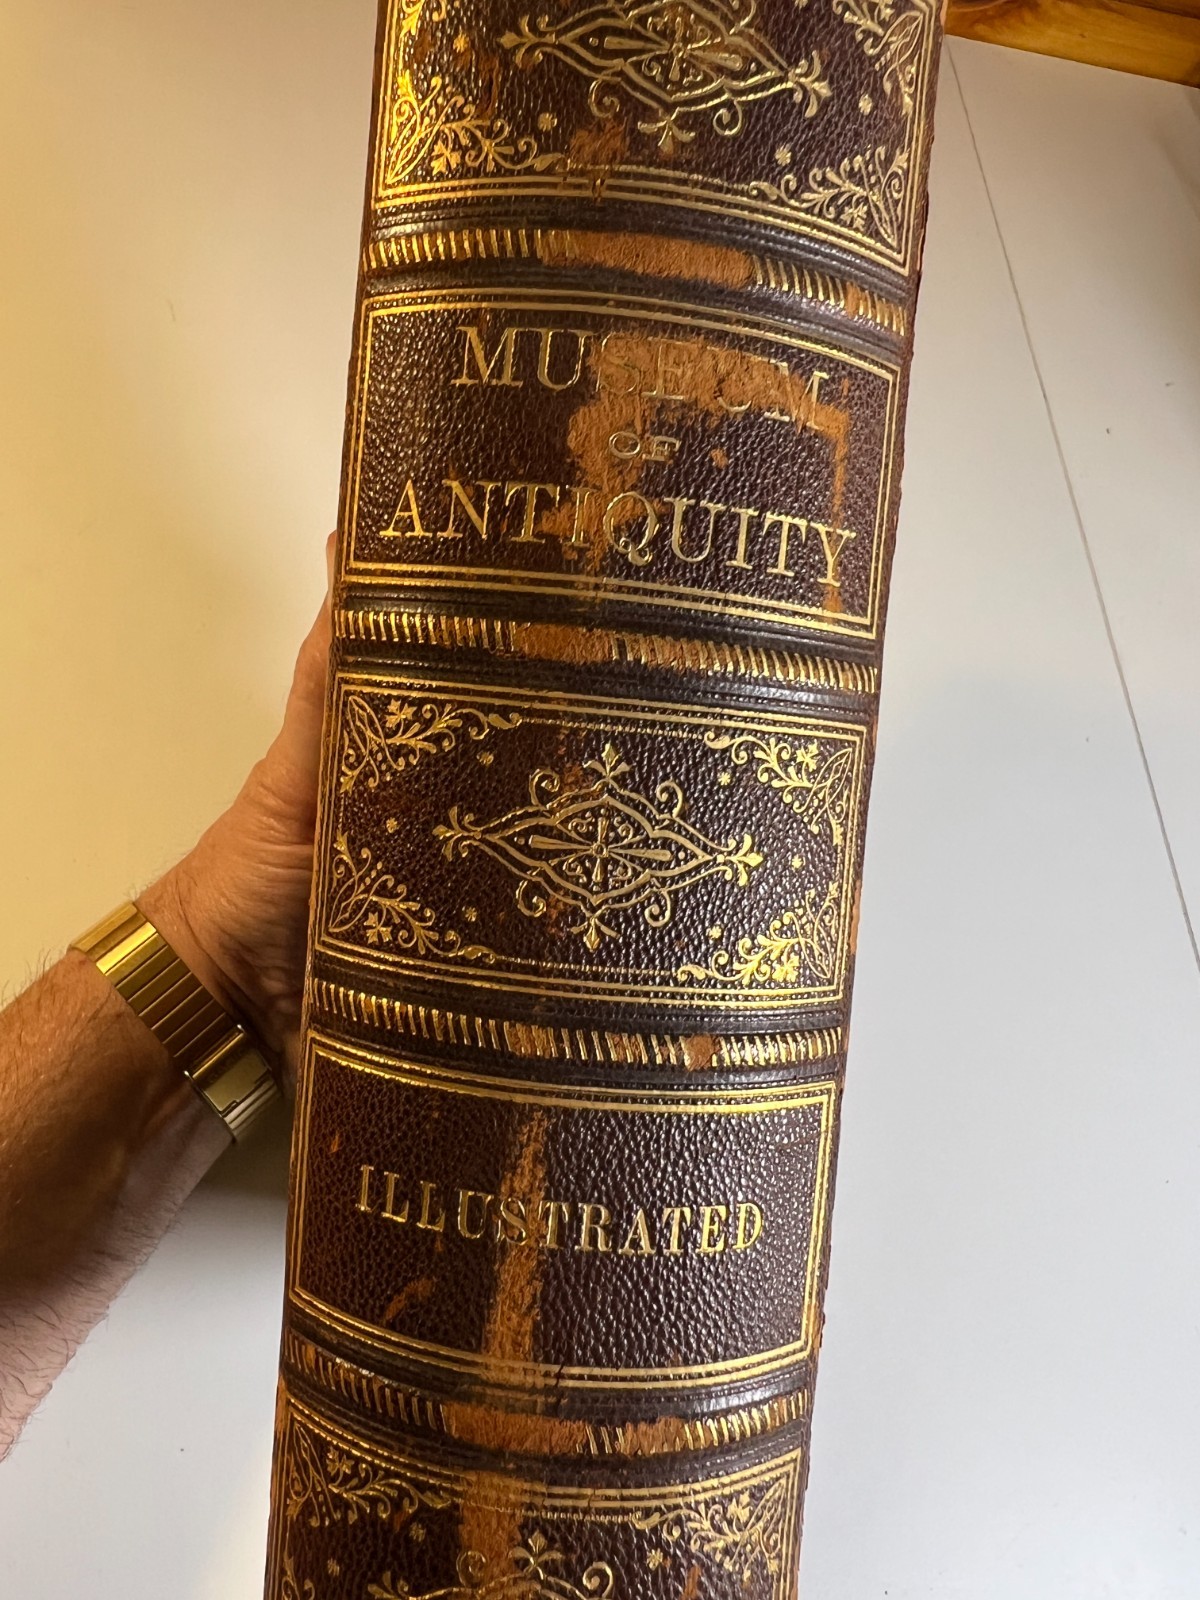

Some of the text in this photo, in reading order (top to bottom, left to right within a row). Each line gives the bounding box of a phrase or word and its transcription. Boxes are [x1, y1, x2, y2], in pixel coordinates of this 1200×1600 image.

[608, 430, 680, 462] OF
[380, 478, 856, 588] ANTIQUITY
[355, 1164, 765, 1255] ILLUSTRATED
